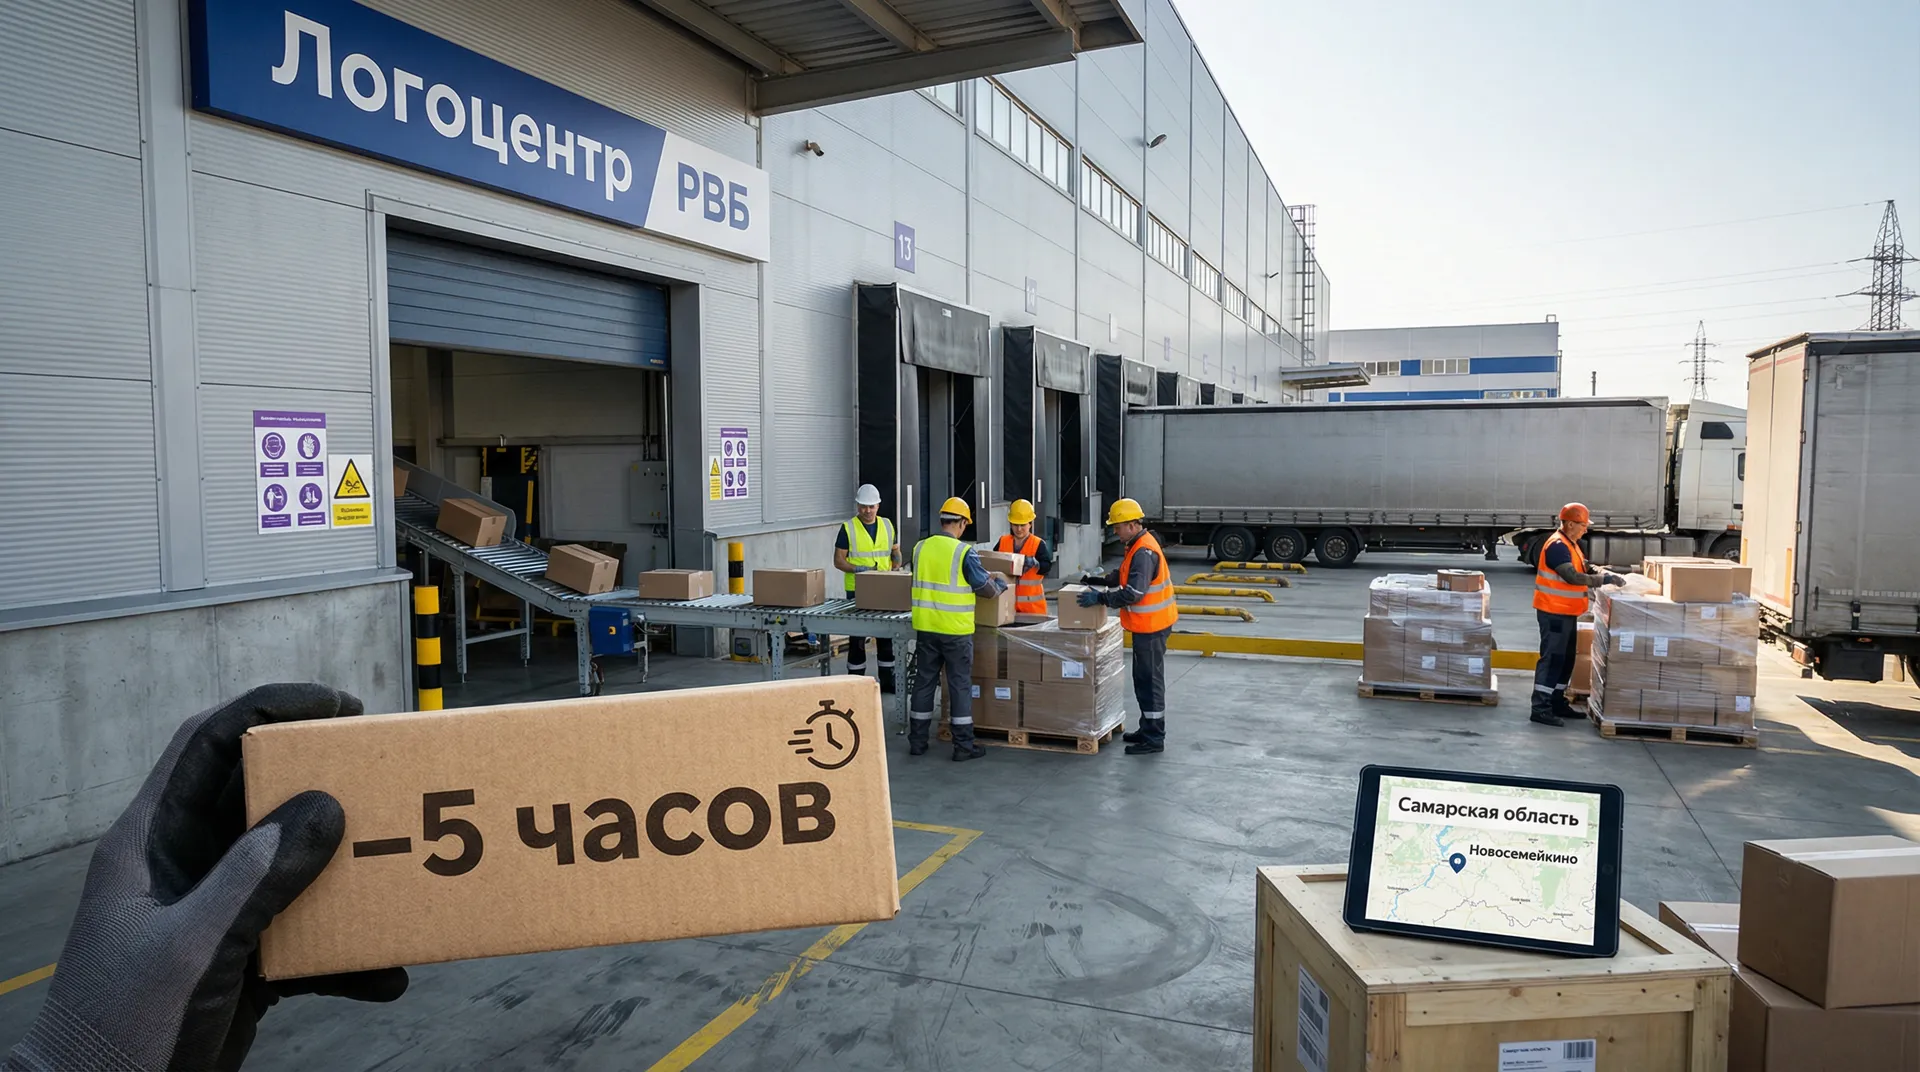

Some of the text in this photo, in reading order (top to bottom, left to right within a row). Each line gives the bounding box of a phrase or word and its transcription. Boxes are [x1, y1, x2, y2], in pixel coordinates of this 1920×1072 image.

[271, 10, 751, 231] Логоцентр РВБ
[898, 234, 912, 261] 13
[516, 781, 837, 866] часов
[1398, 796, 1579, 827] Самарская область
[1469, 844, 1579, 865] Новосемейкино
